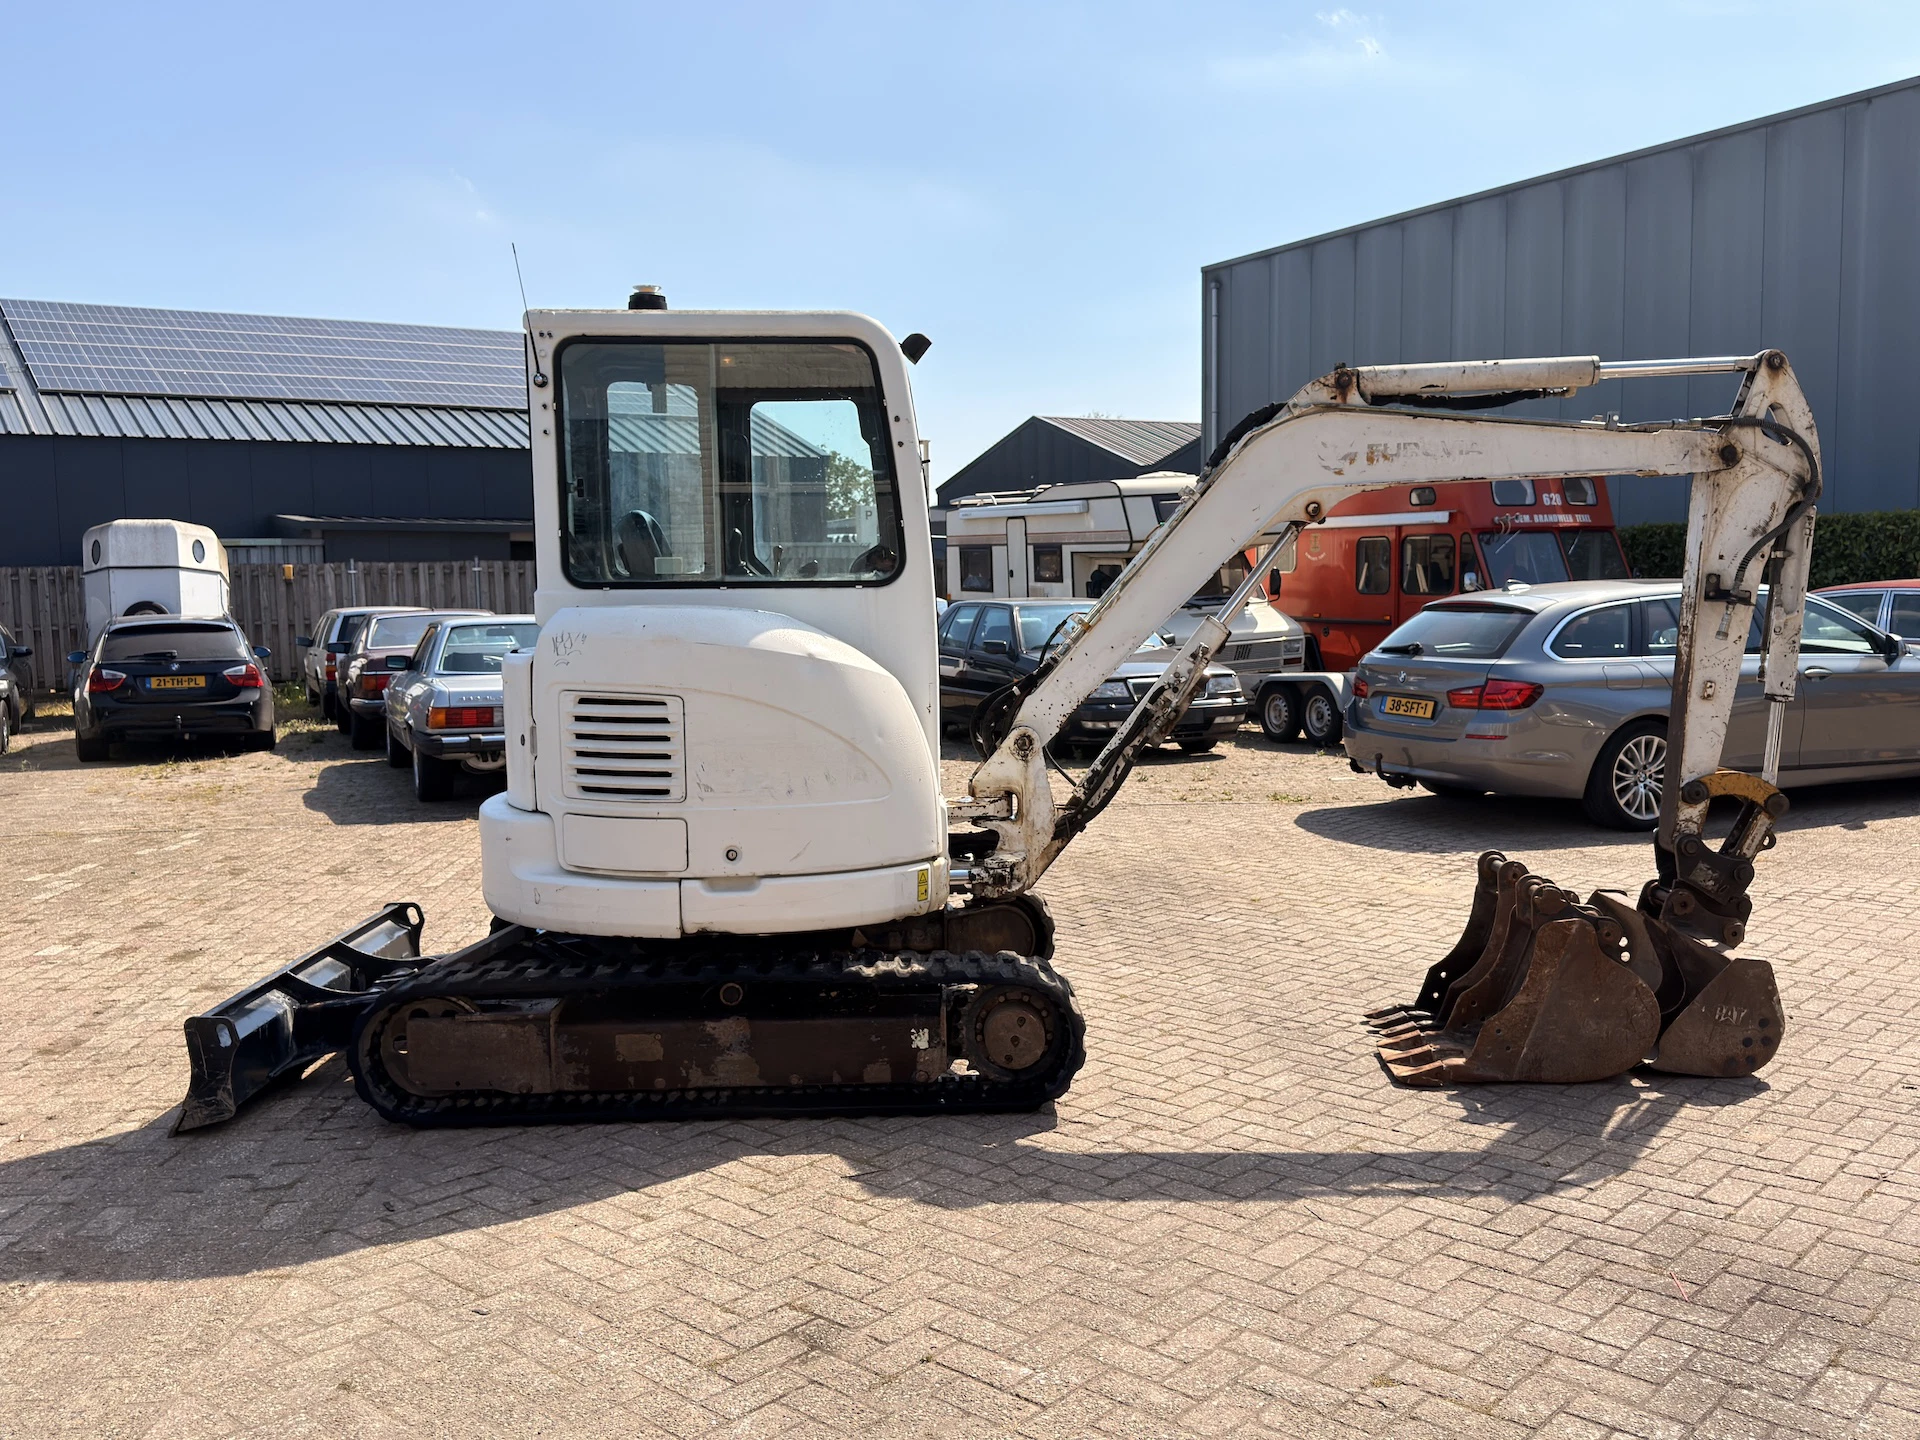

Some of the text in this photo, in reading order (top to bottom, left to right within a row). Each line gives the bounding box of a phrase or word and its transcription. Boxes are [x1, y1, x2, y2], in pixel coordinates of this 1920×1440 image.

[865, 510, 873, 520] P
[156, 677, 200, 687] 21-TH-PL
[1389, 699, 1428, 715] 38-SFT-1
